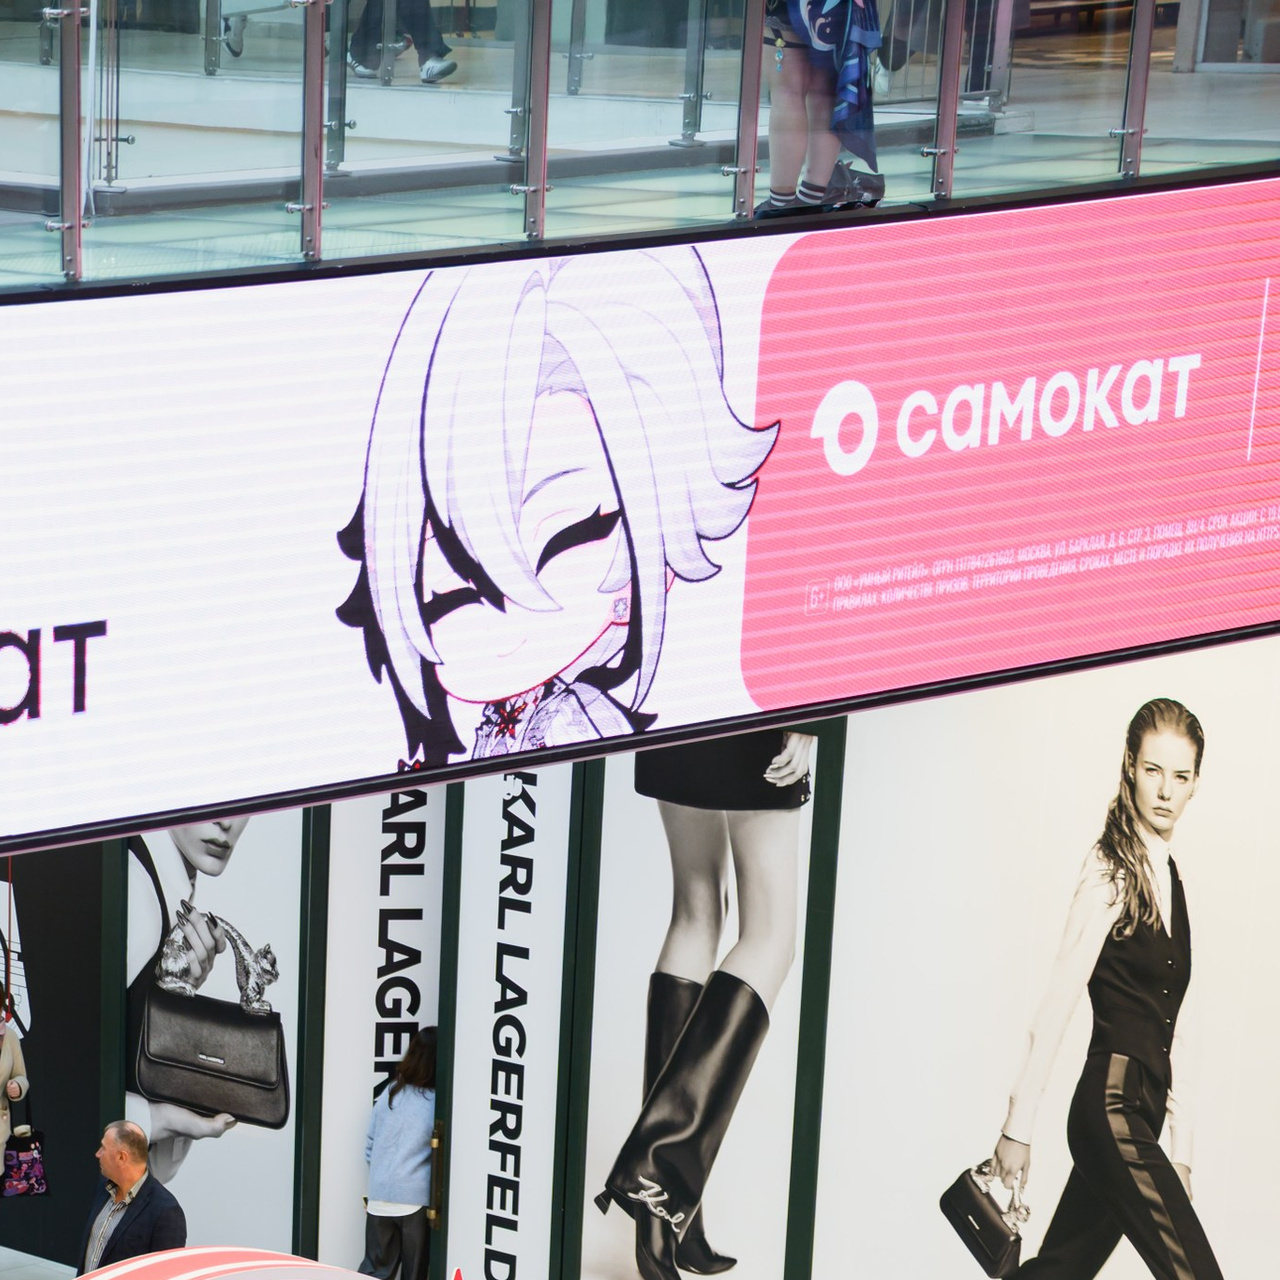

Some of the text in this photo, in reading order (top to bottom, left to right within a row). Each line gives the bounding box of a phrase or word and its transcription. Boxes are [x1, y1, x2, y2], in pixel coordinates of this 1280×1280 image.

[896, 353, 1202, 460] самокат
[380, 788, 428, 896] ARL
[497, 770, 538, 930] KARL
